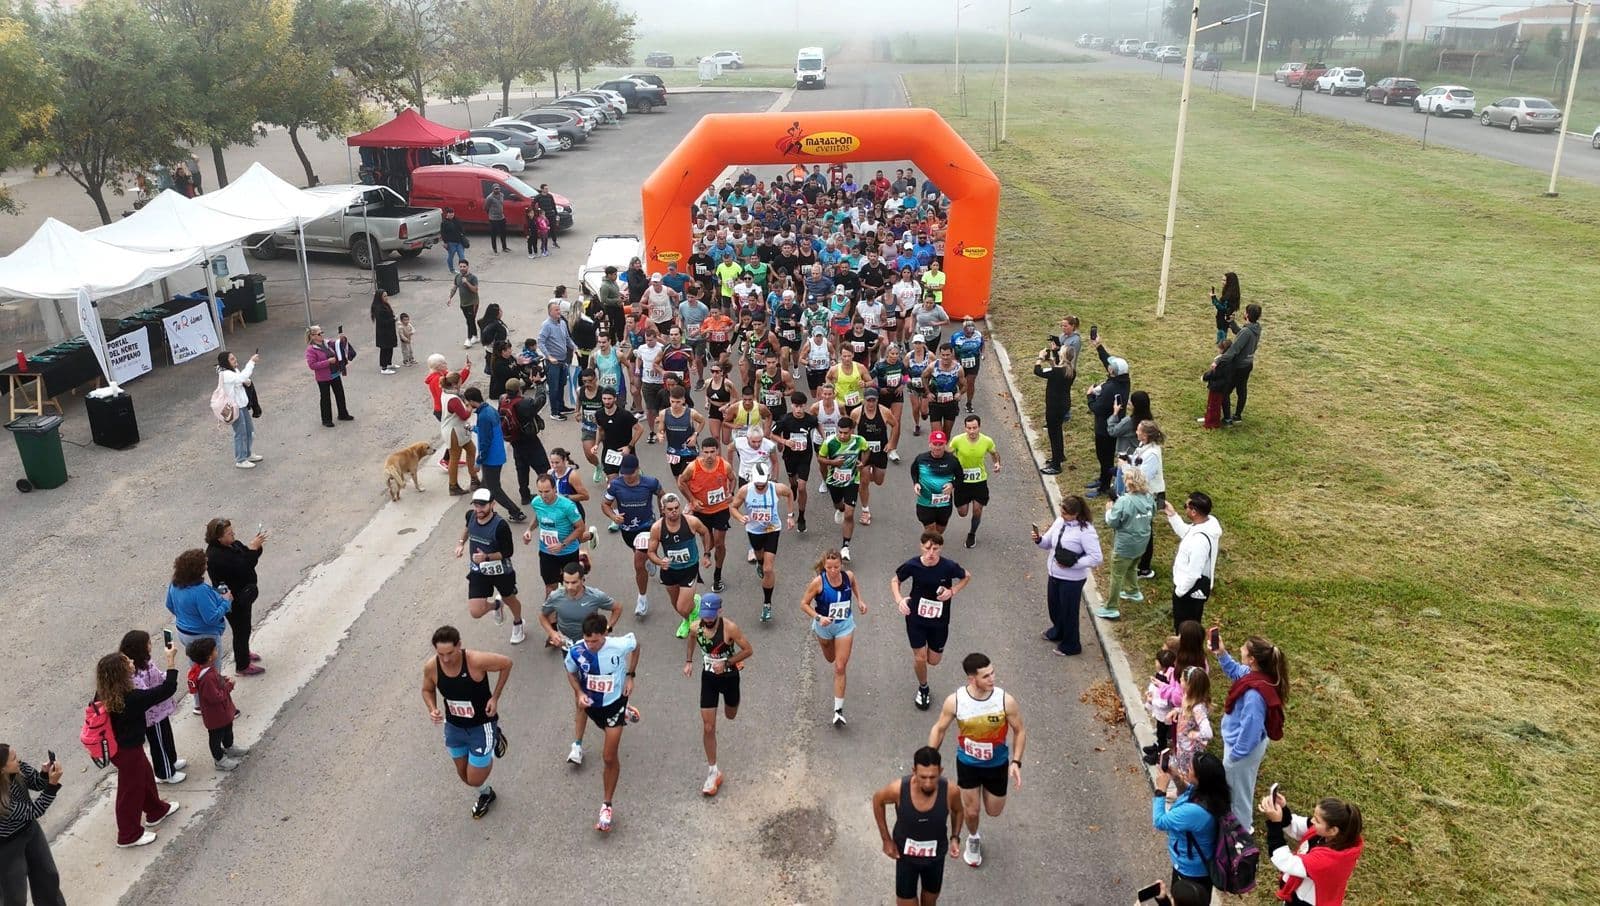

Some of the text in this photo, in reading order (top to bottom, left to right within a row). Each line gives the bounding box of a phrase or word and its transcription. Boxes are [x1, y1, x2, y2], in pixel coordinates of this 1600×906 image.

[806, 137, 853, 146] MARATHON
[815, 145, 850, 153] eventos
[107, 337, 128, 350] PORTAL
[109, 343, 139, 358] DEL NORTE
[673, 534, 681, 544] C
[481, 564, 503, 576] 238
[920, 604, 942, 618] 647
[588, 680, 614, 692] 697
[964, 744, 992, 760] 635
[906, 847, 937, 858] 641
